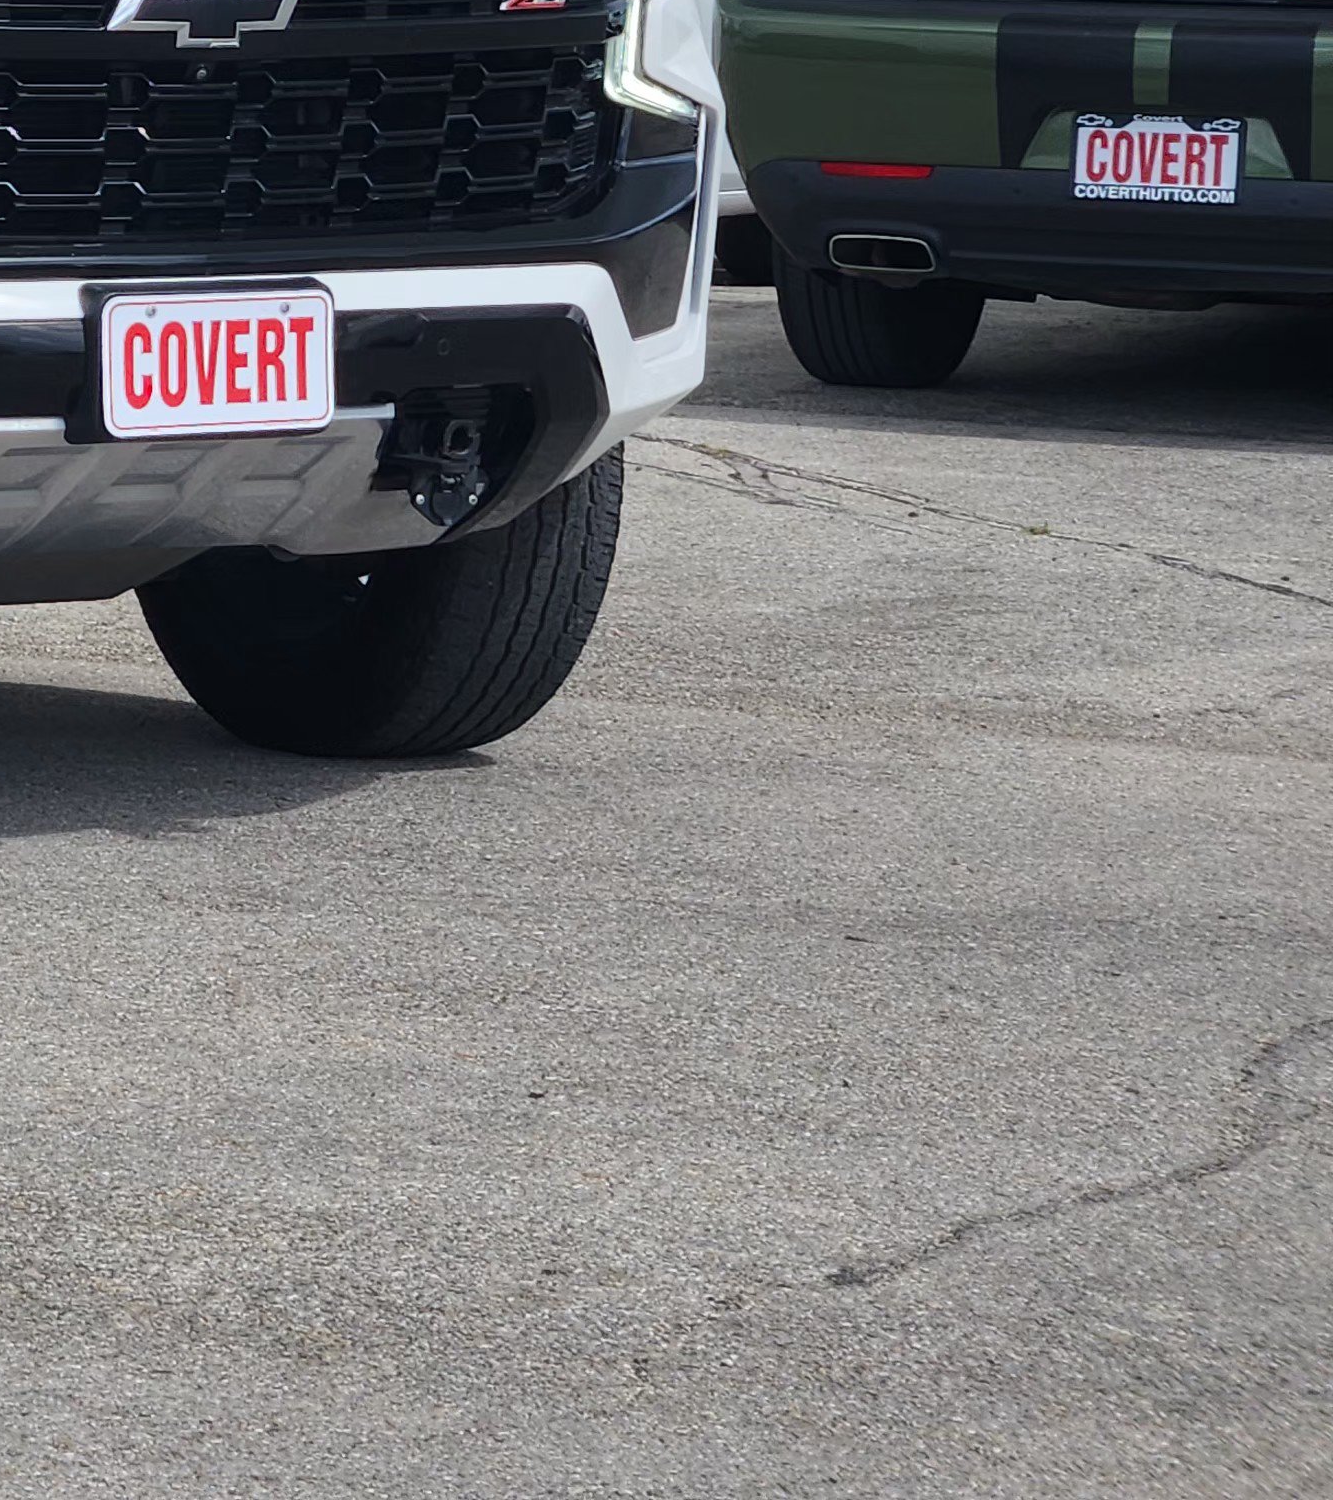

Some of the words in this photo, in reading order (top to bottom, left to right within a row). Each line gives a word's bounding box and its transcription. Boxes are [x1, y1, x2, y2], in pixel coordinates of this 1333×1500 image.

[1085, 129, 1230, 187] COVERT
[1074, 185, 1236, 204] COVERTHUTTO.COM
[124, 316, 315, 410] COVERT
